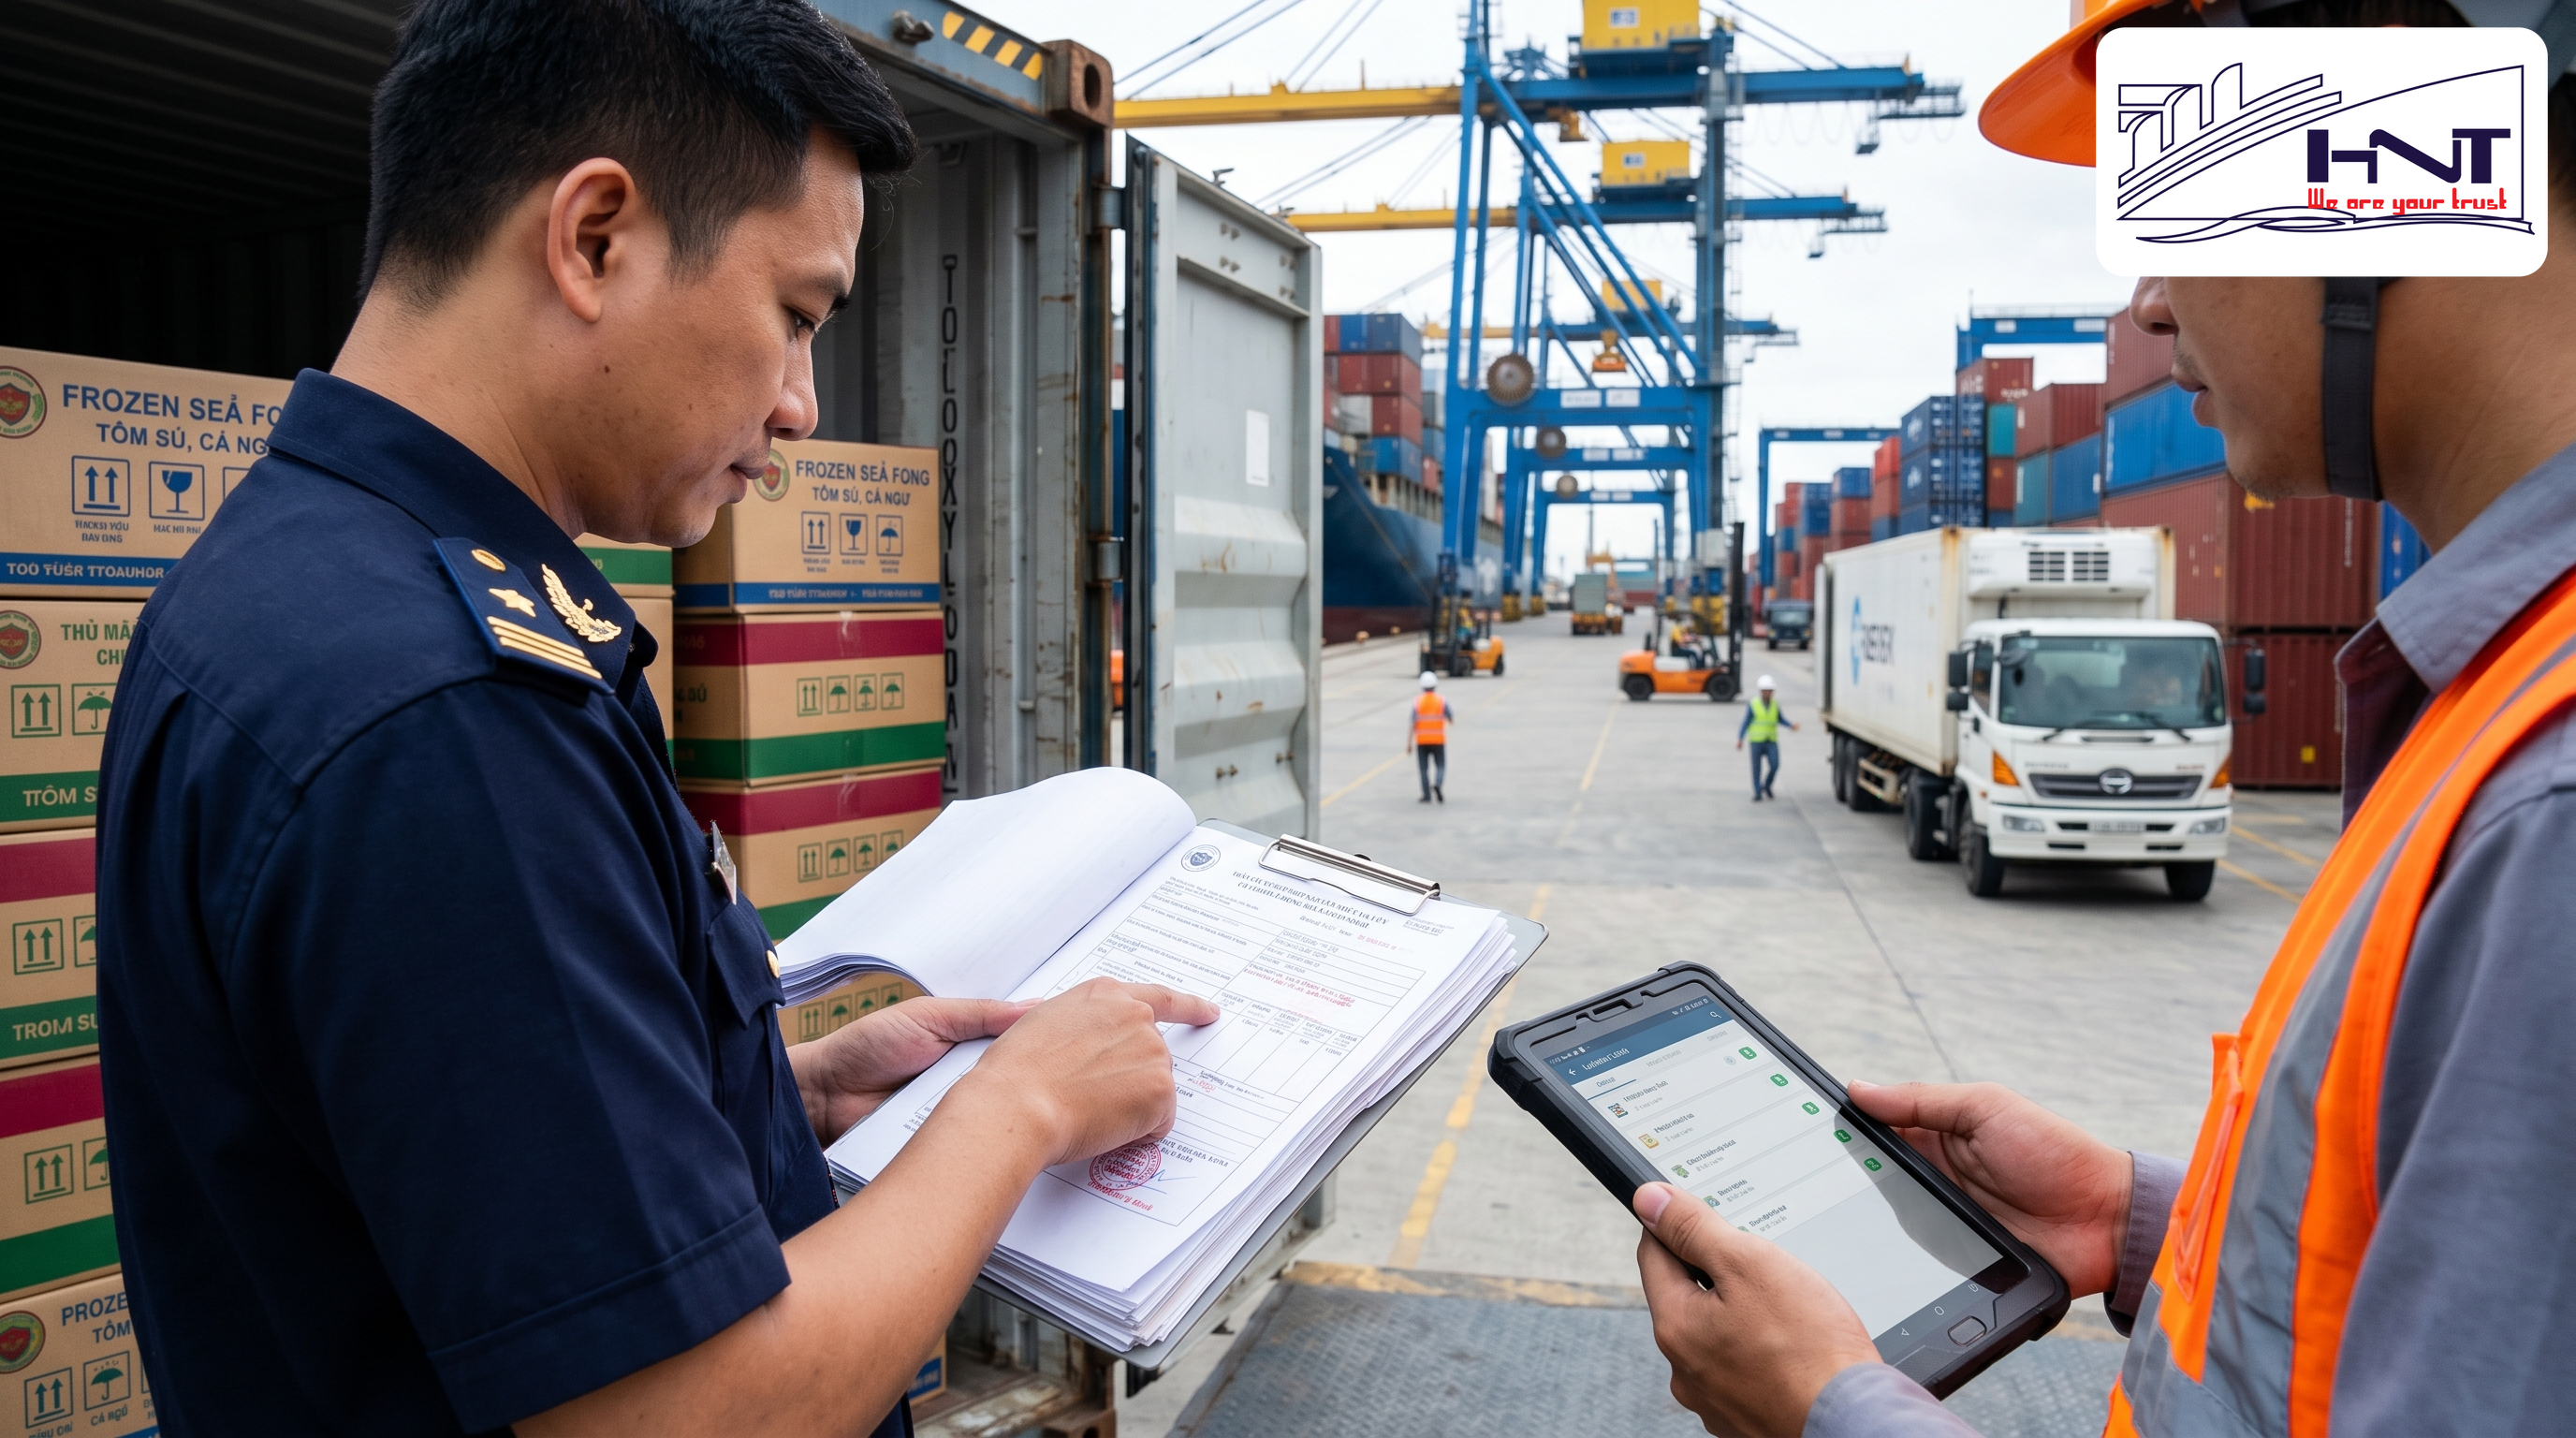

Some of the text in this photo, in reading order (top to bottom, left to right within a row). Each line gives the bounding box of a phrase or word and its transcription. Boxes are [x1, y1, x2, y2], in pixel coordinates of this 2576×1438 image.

[63, 384, 179, 418] FROZEN
[96, 420, 148, 447] TÔM
[796, 460, 856, 480] FROZEN
[892, 467, 930, 487] FONG
[812, 484, 839, 502] TÔM
[92, 1319, 131, 1343] TÔM
